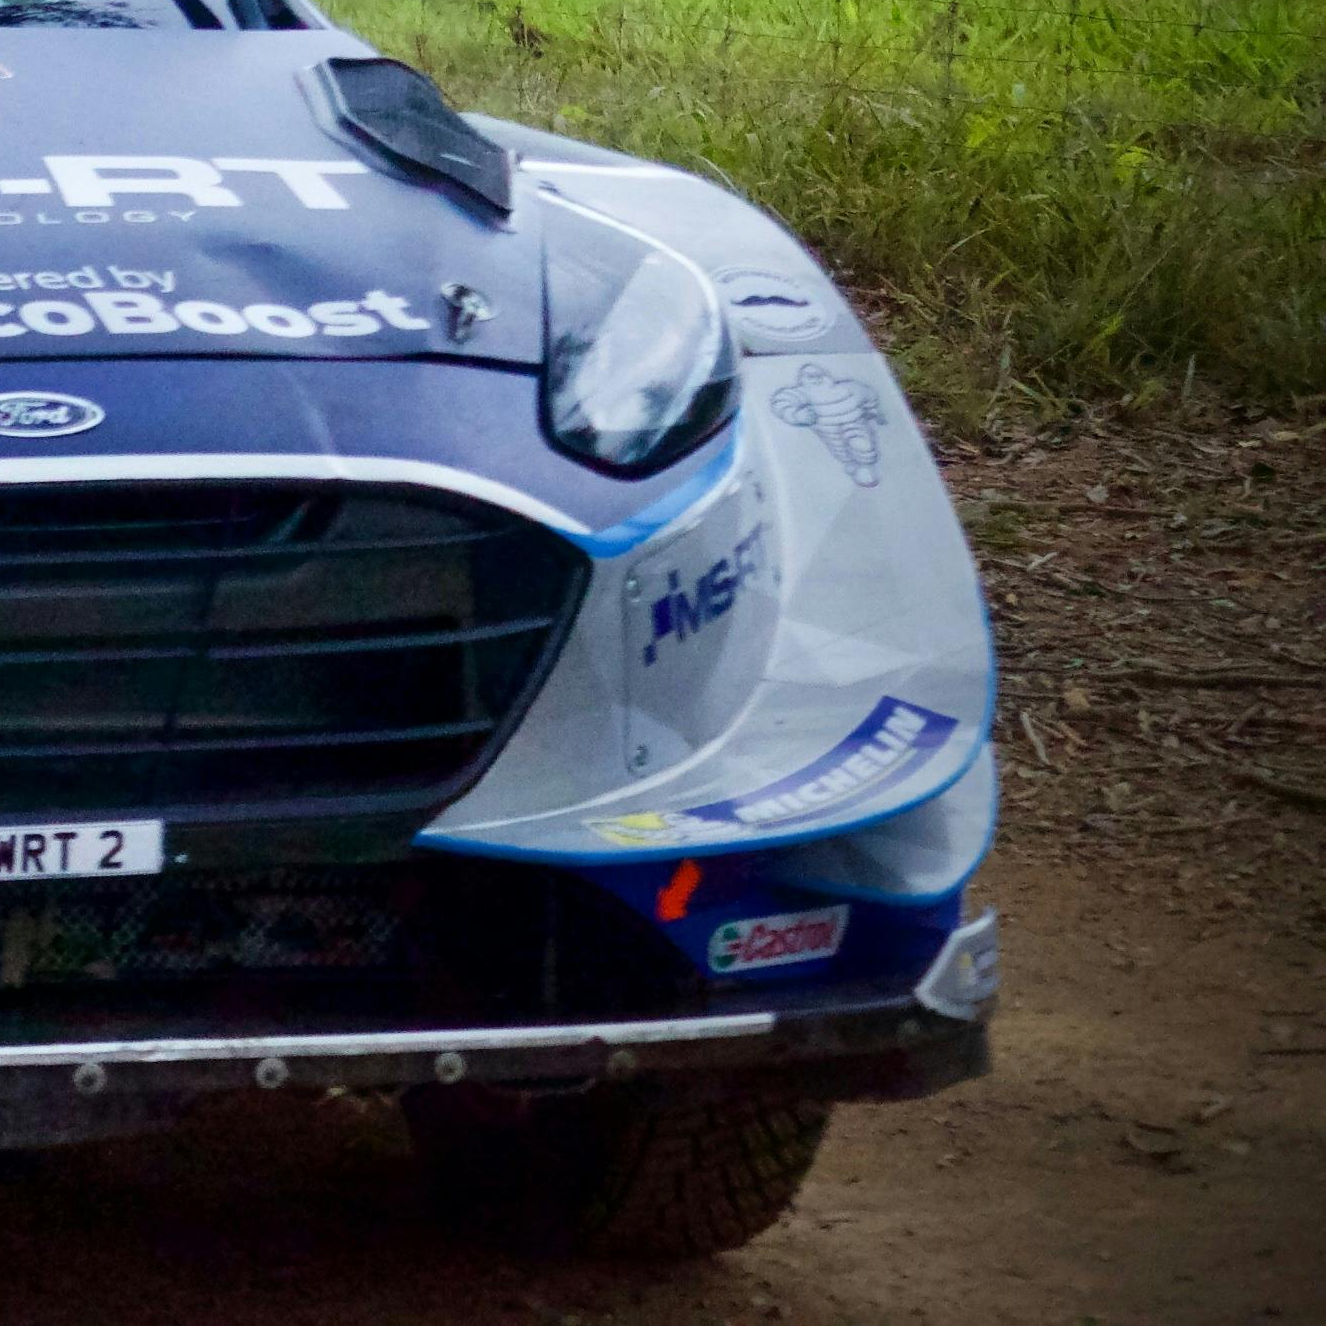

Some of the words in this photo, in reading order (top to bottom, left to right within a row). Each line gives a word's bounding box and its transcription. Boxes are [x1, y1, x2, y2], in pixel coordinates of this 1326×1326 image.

[109, 265, 177, 294] by
[733, 706, 928, 824] MICHELIN
[98, 829, 124, 870] 2
